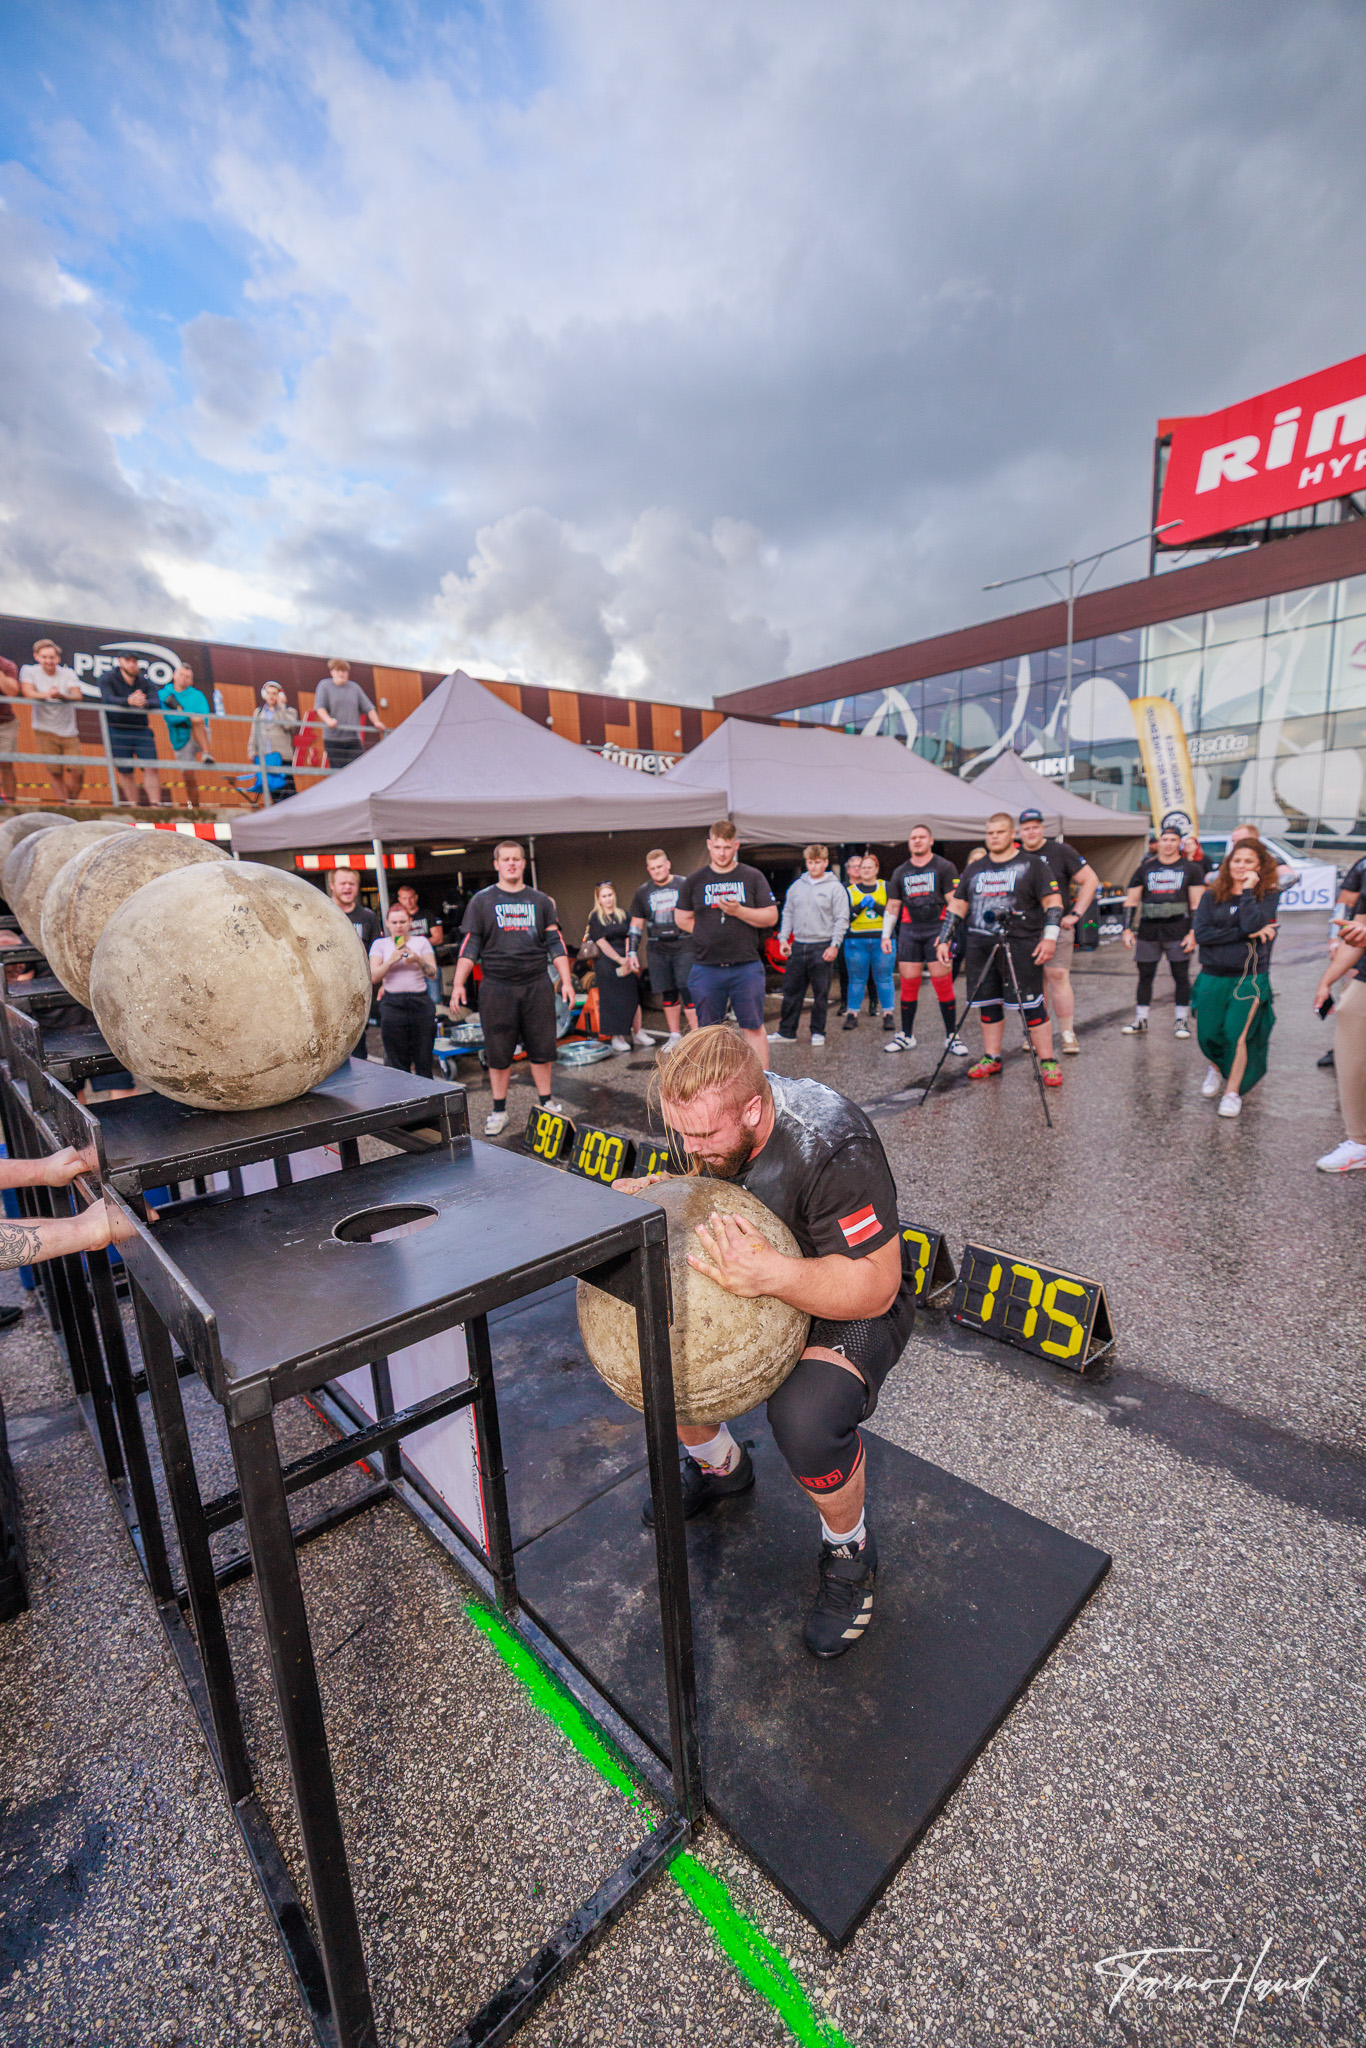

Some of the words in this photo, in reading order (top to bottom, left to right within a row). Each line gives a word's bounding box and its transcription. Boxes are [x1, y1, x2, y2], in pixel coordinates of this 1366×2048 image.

[1188, 735, 1248, 754] Betta
[1279, 889, 1330, 905] DUS
[533, 1112, 563, 1159] 90
[578, 1130, 623, 1182] 100
[980, 1263, 1085, 1359] 175
[803, 1473, 840, 1488] SBD
